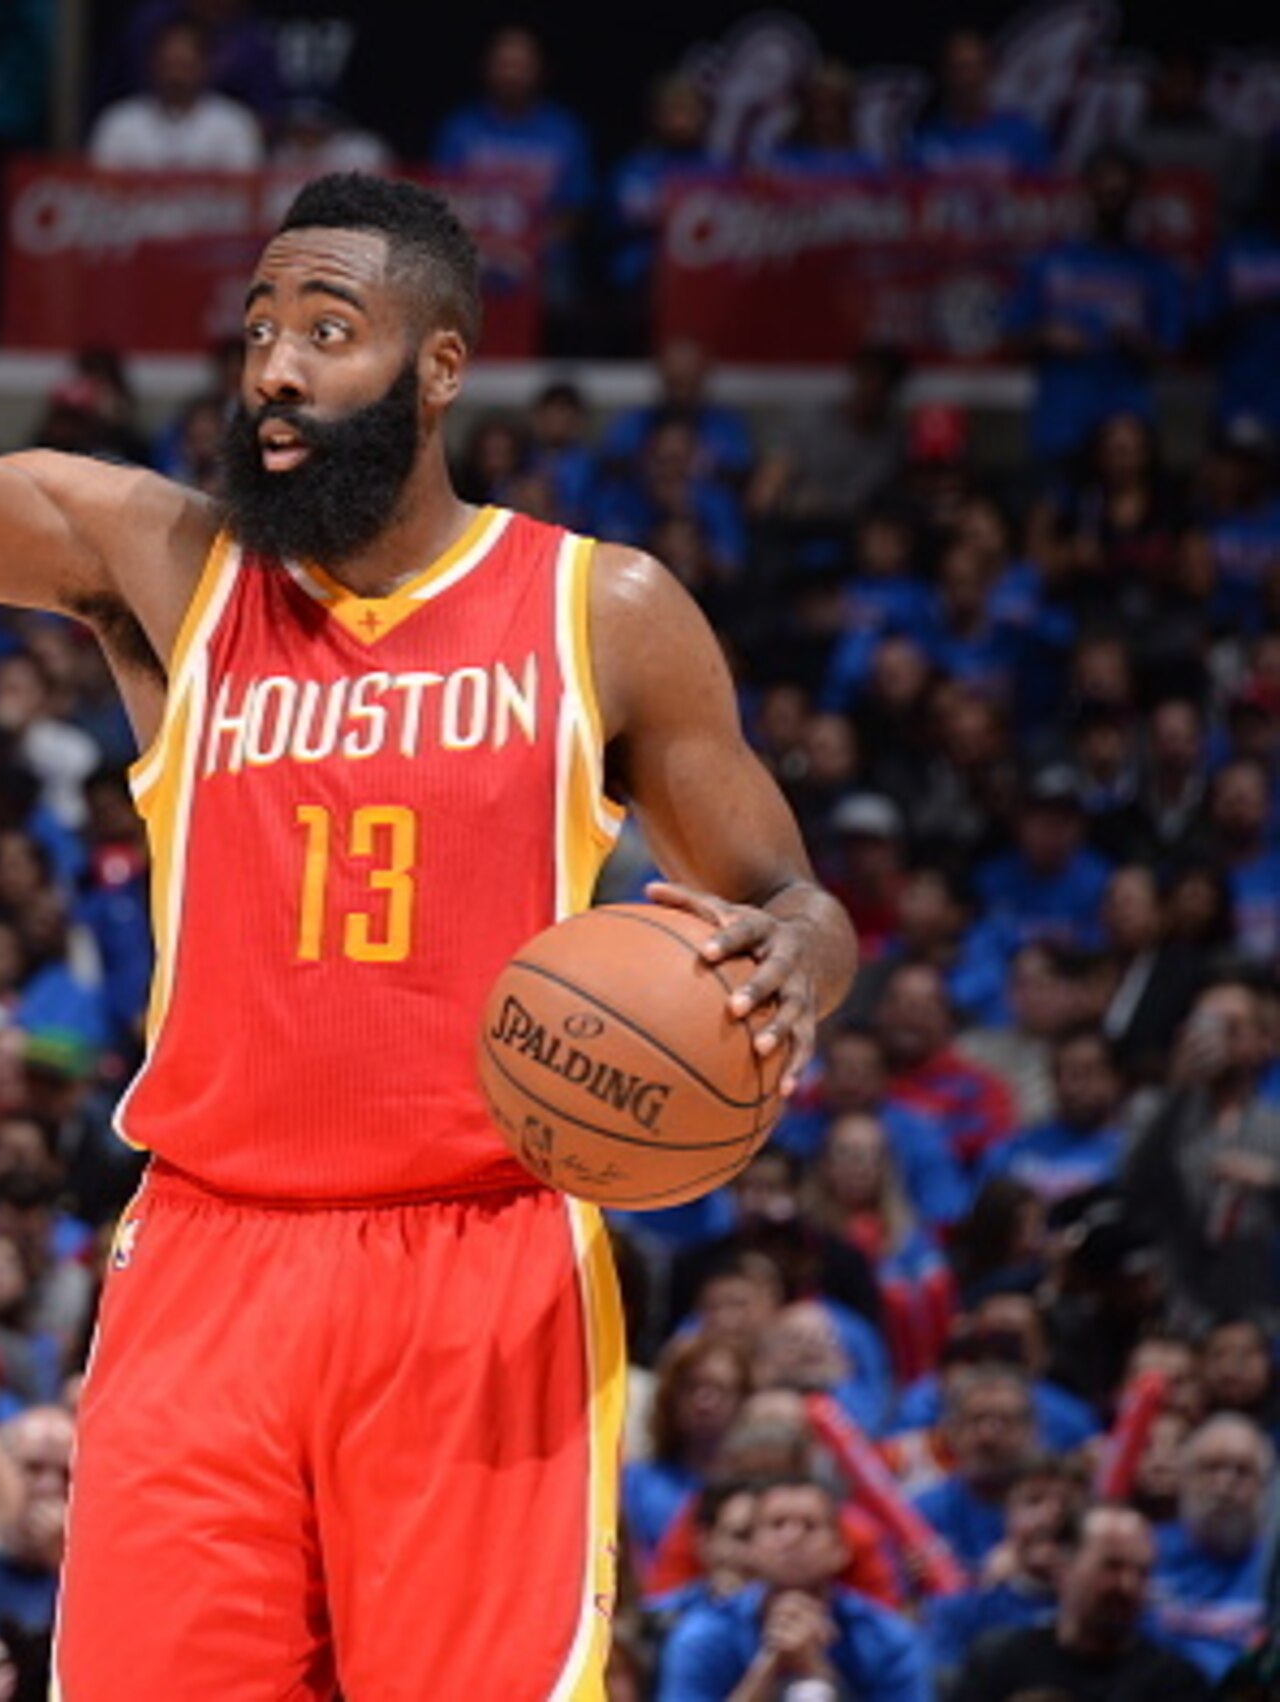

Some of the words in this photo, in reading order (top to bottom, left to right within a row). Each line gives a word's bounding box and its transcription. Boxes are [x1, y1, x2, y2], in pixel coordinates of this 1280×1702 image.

[203, 652, 539, 779] HOUSTON
[297, 804, 418, 962] 13
[491, 995, 672, 1129] SPALDING
